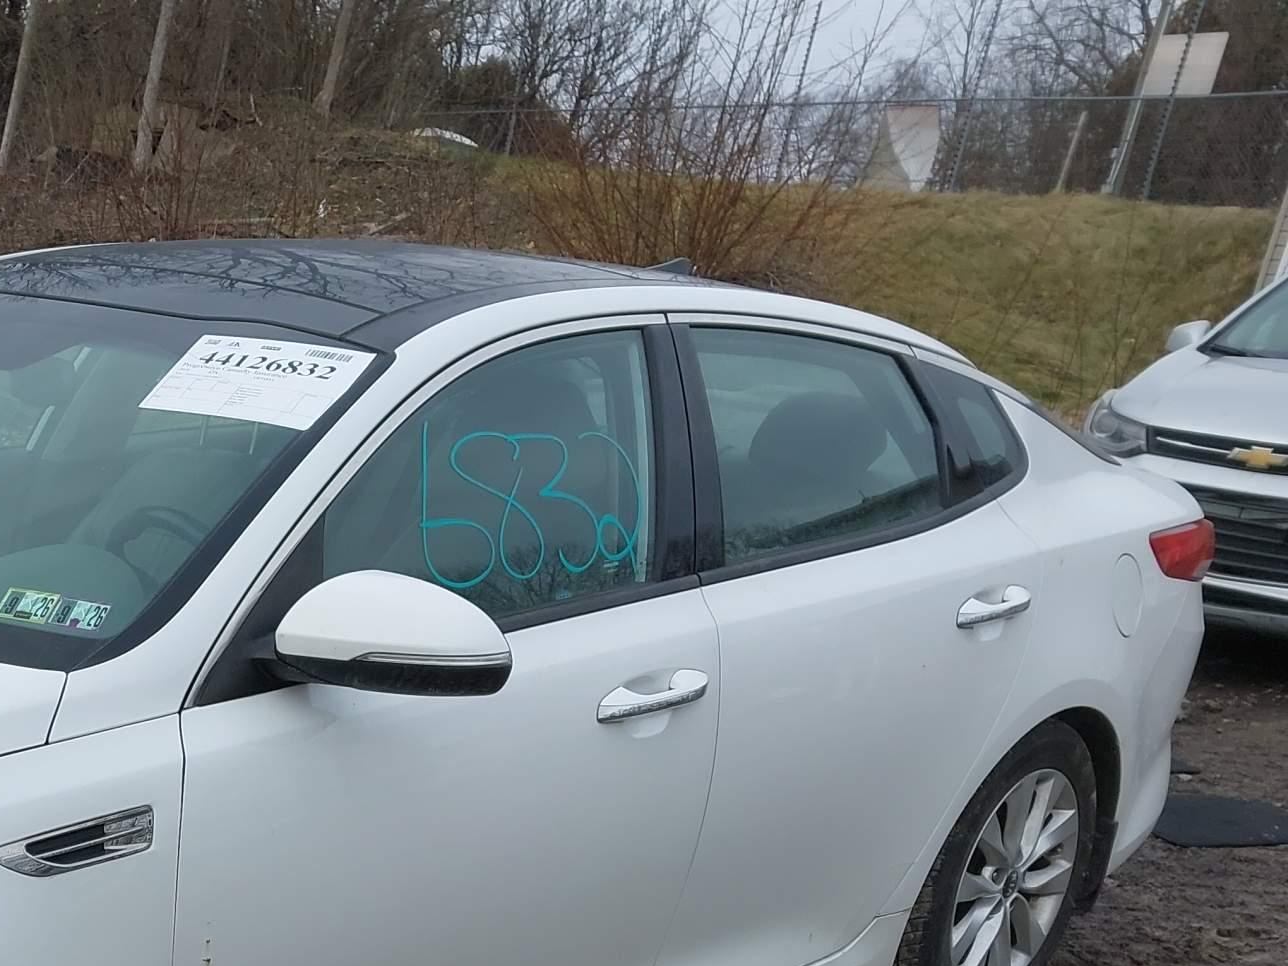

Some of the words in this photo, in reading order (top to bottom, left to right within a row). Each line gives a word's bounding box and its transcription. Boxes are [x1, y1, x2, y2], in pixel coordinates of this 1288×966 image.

[199, 351, 337, 380] 44126832
[419, 420, 642, 590] 6832
[33, 597, 55, 618] 26
[86, 606, 109, 628] 26
